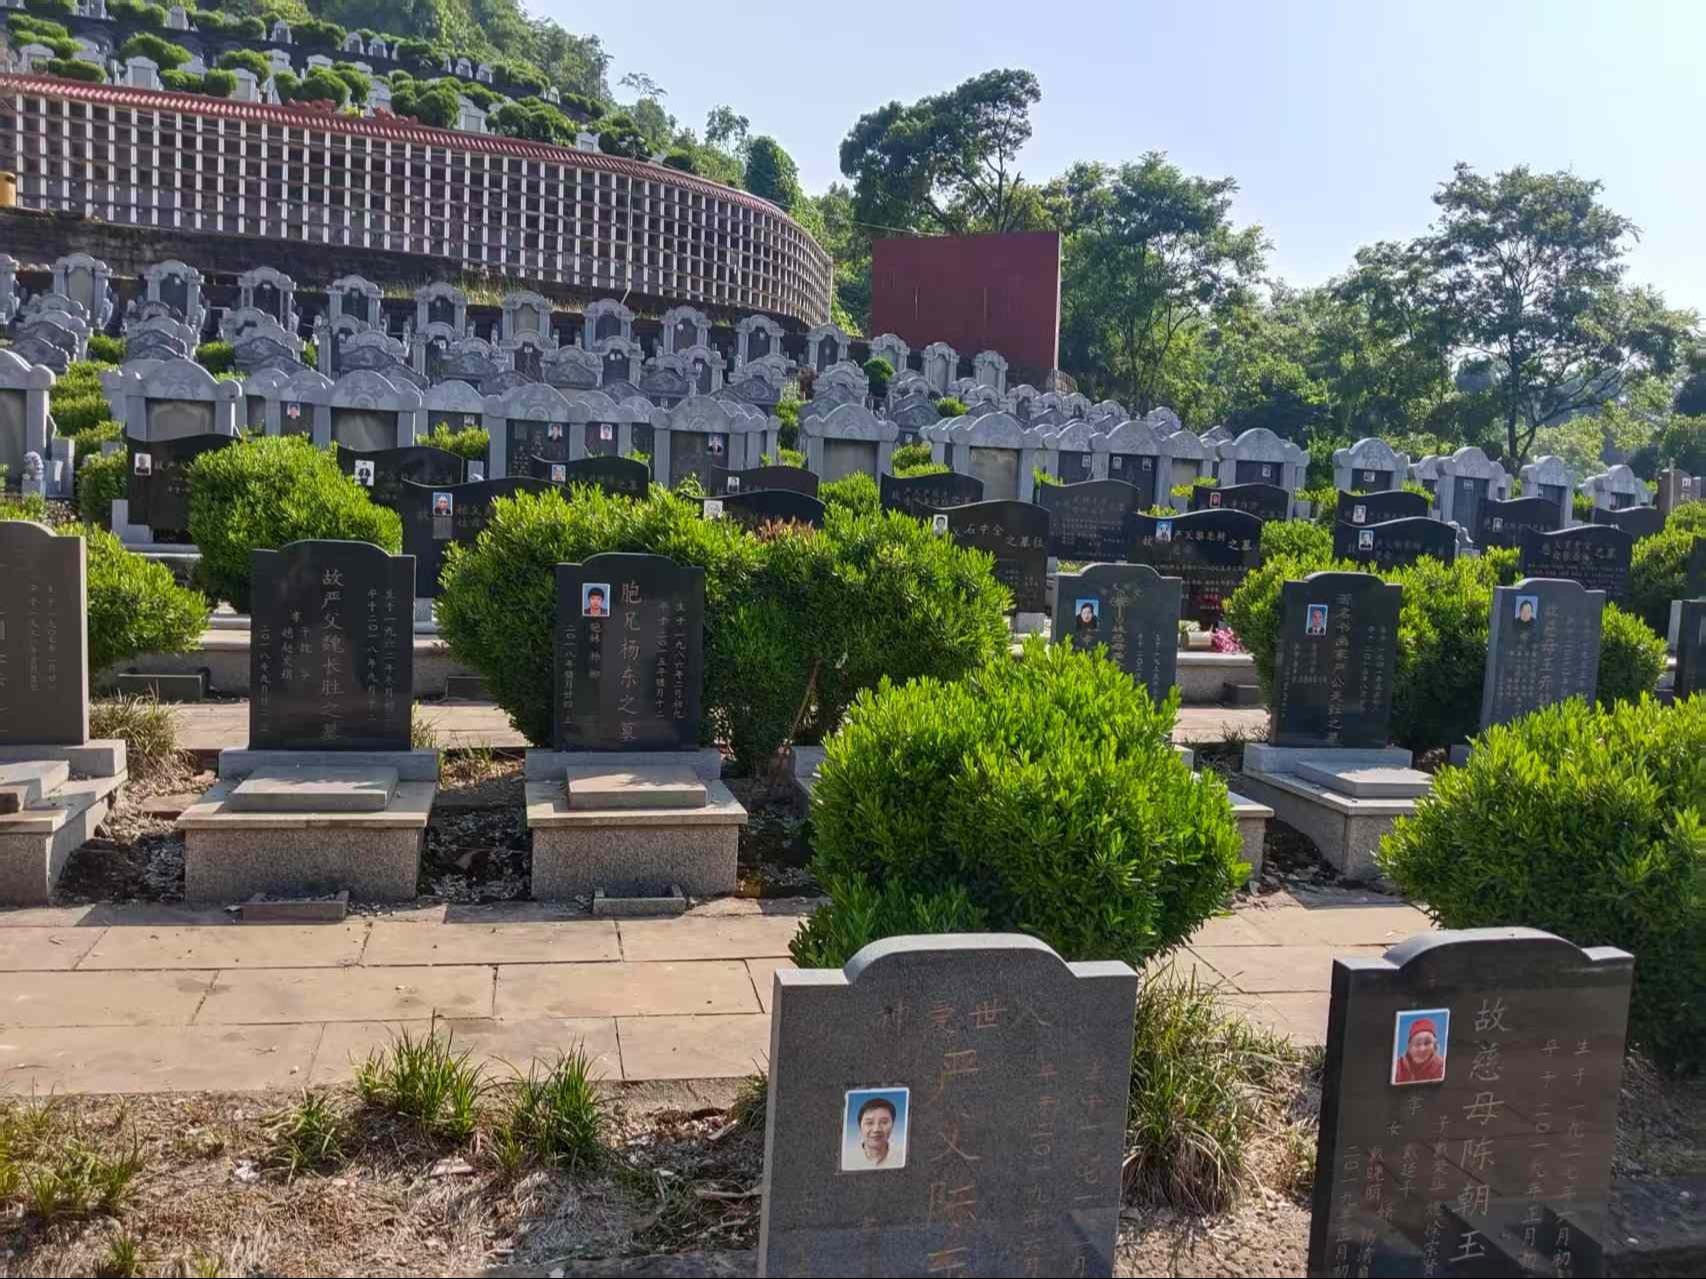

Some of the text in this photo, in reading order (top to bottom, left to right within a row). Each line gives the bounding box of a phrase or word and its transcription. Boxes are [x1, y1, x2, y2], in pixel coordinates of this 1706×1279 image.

[1449, 996, 1512, 1264] 故慈母陈朝玉
